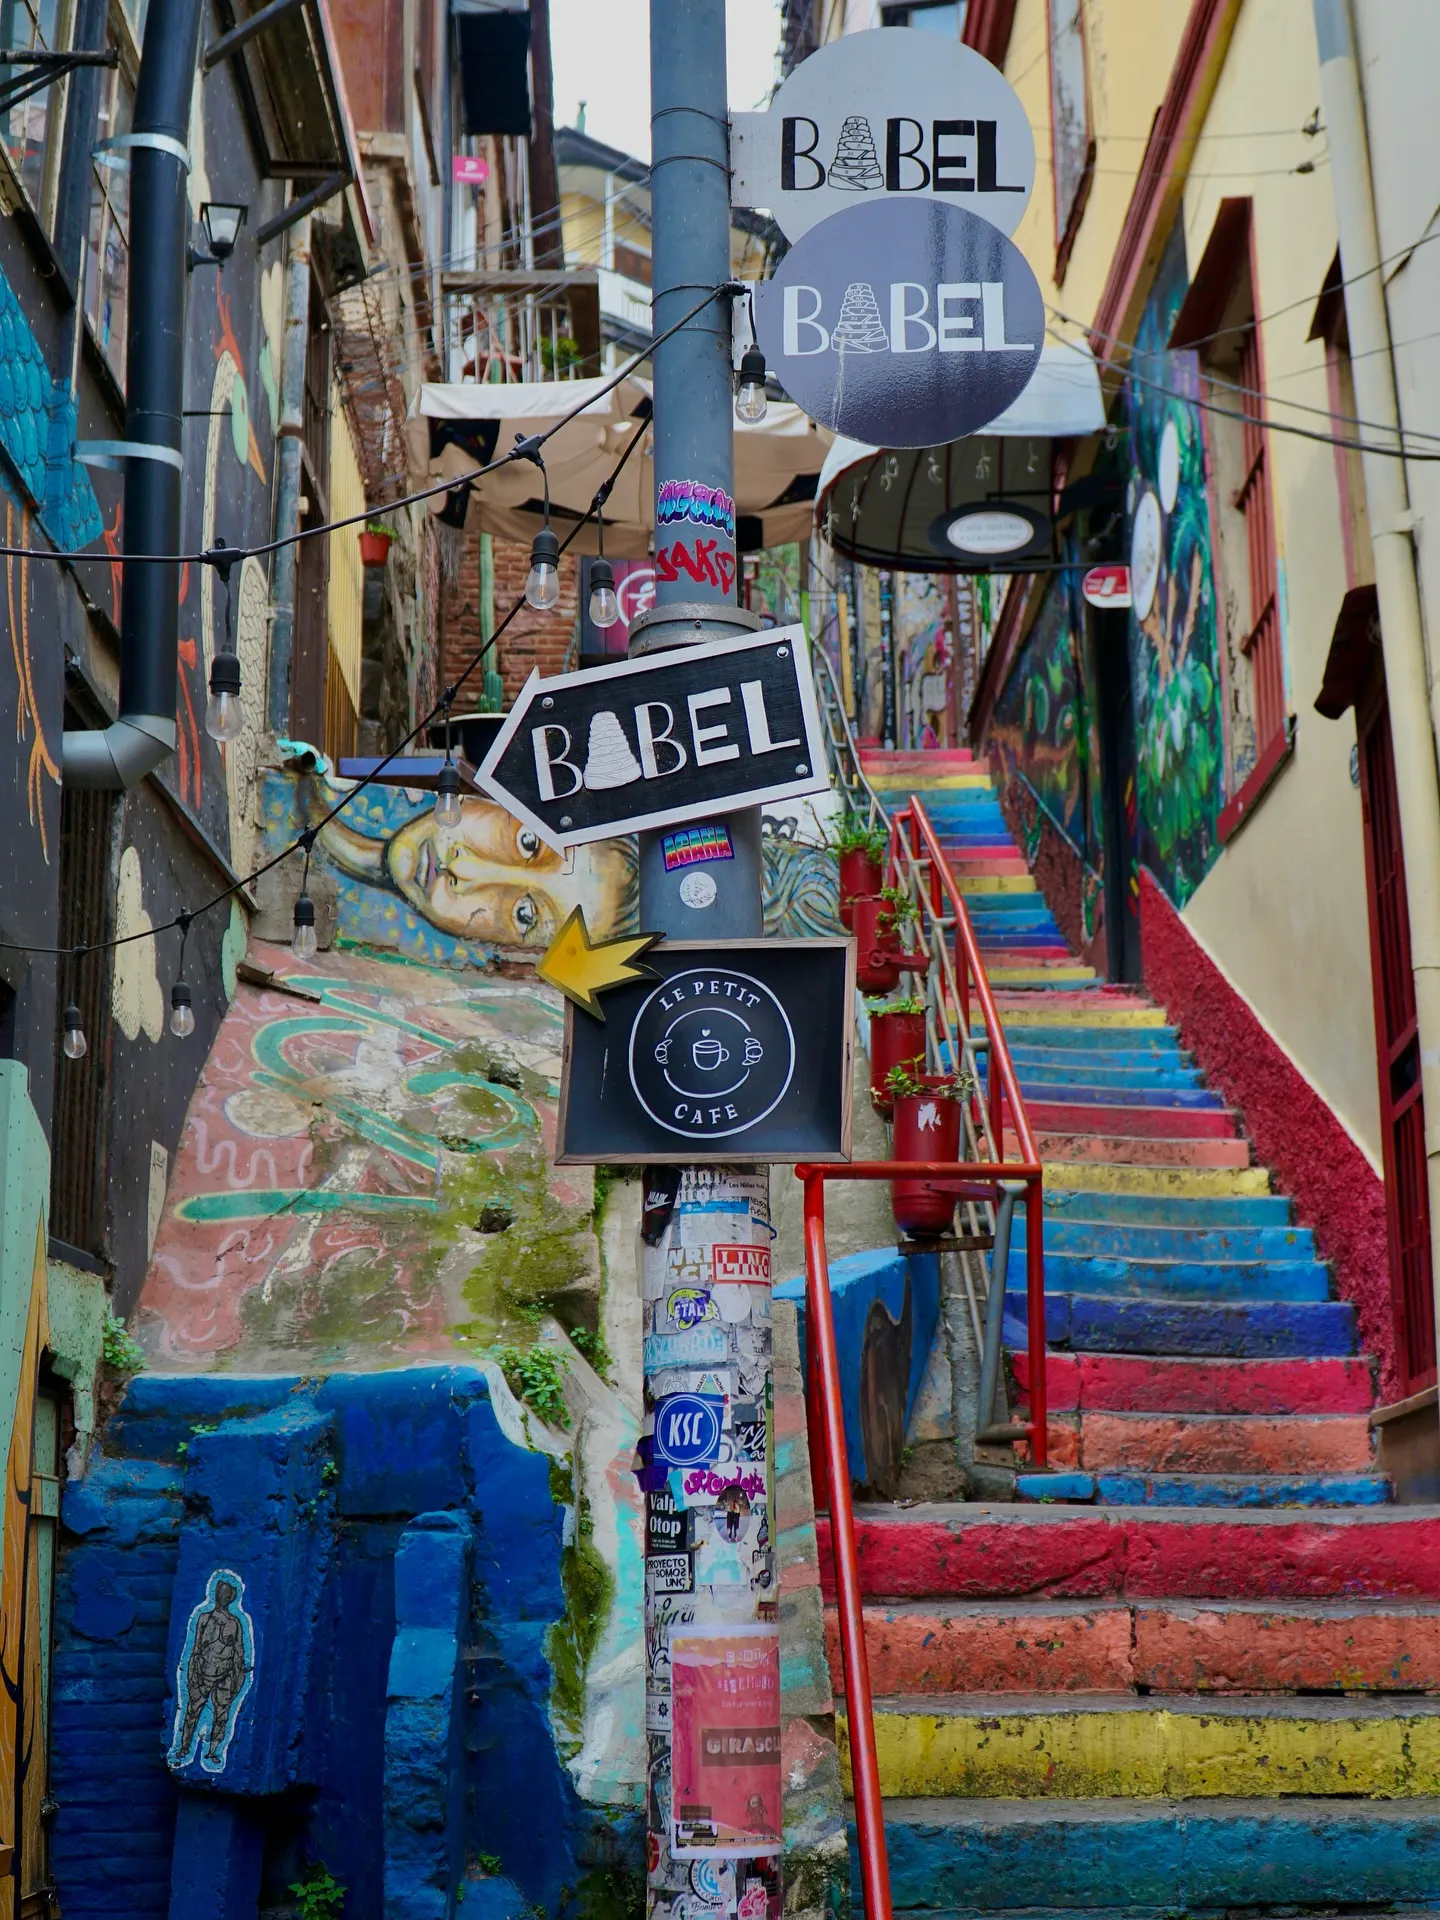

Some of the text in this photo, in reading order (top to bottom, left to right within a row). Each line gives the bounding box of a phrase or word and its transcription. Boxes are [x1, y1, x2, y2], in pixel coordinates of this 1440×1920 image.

[664, 826, 732, 870] AGANA
[659, 980, 761, 1011] LE PETIT
[674, 1103, 738, 1124] CAFE
[668, 1413, 704, 1447] KSC
